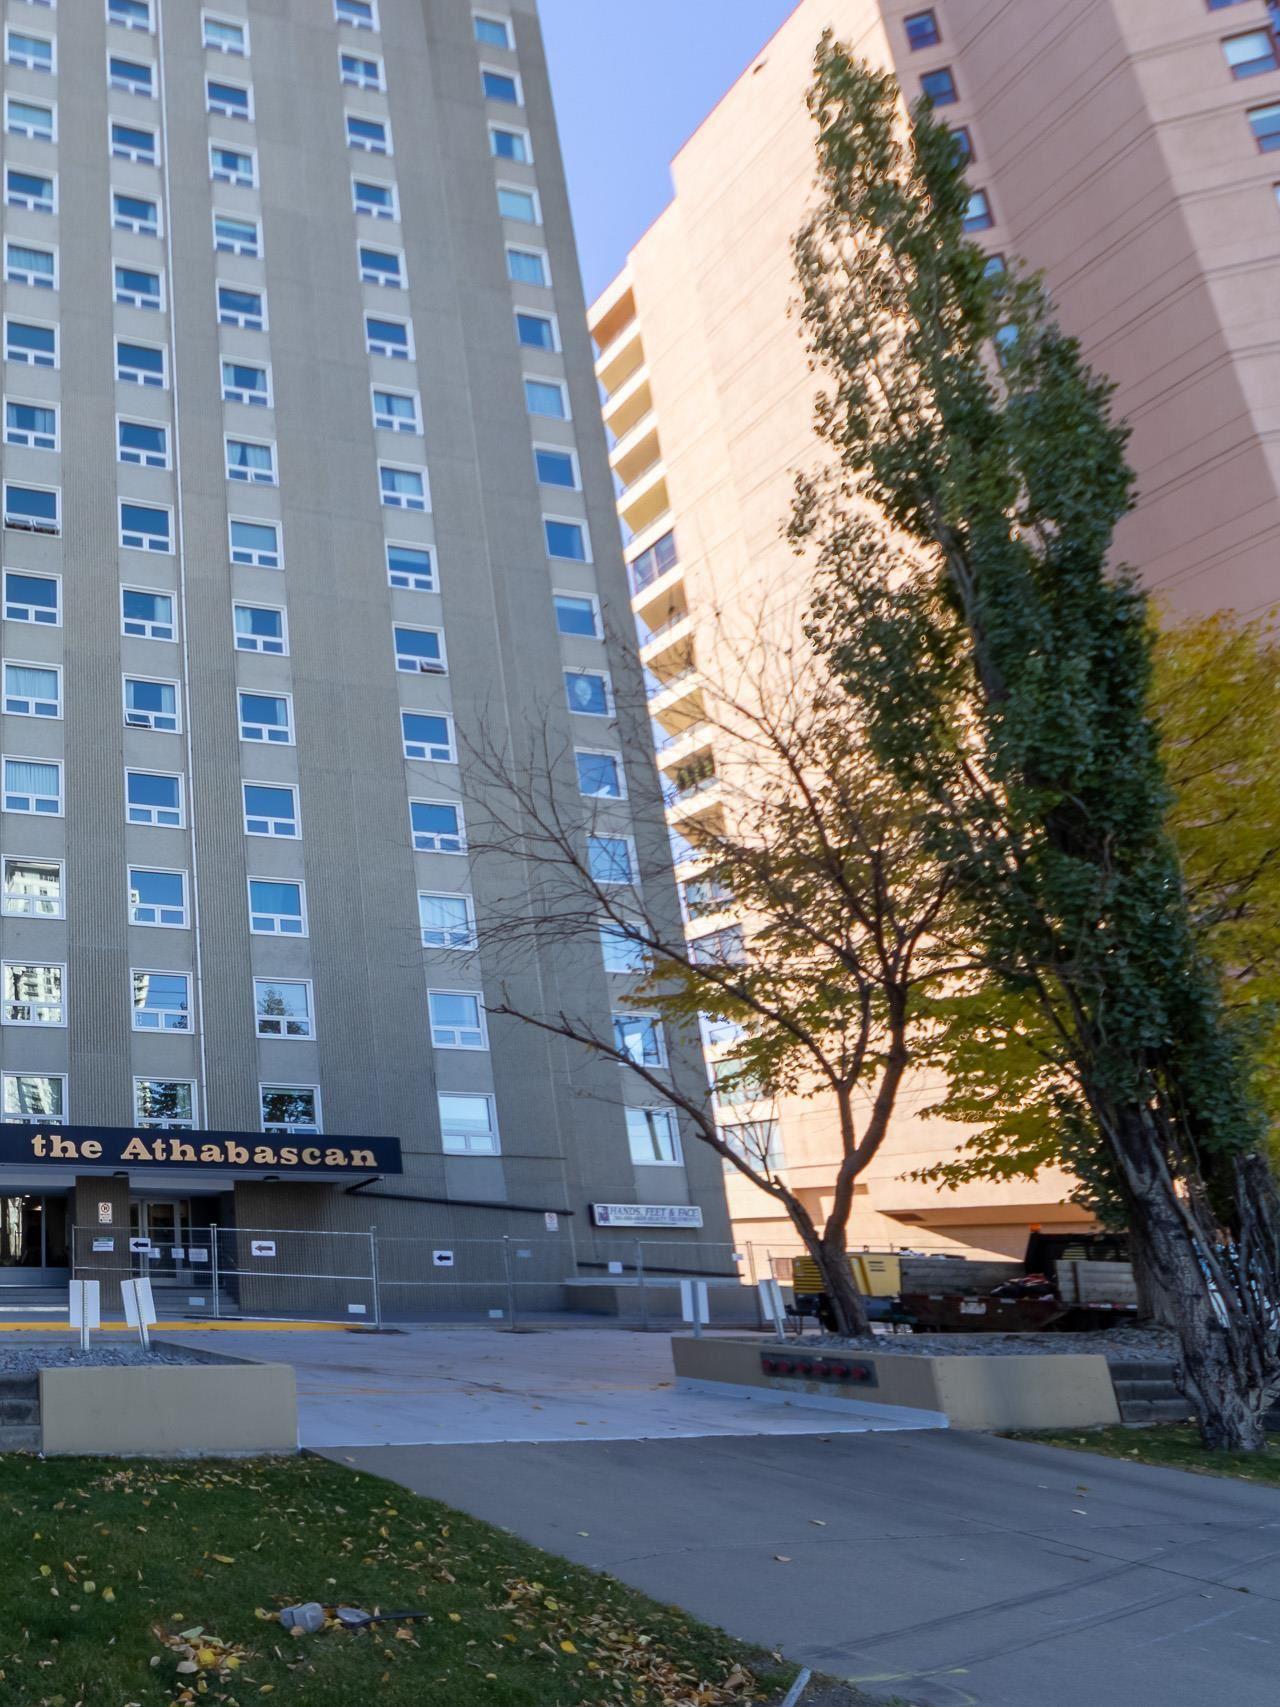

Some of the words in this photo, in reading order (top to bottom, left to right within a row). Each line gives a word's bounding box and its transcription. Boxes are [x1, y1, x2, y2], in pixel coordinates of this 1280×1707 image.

[31, 1134, 103, 1159] the
[120, 1137, 378, 1167] Athabascan
[645, 1207, 666, 1217] FEET
